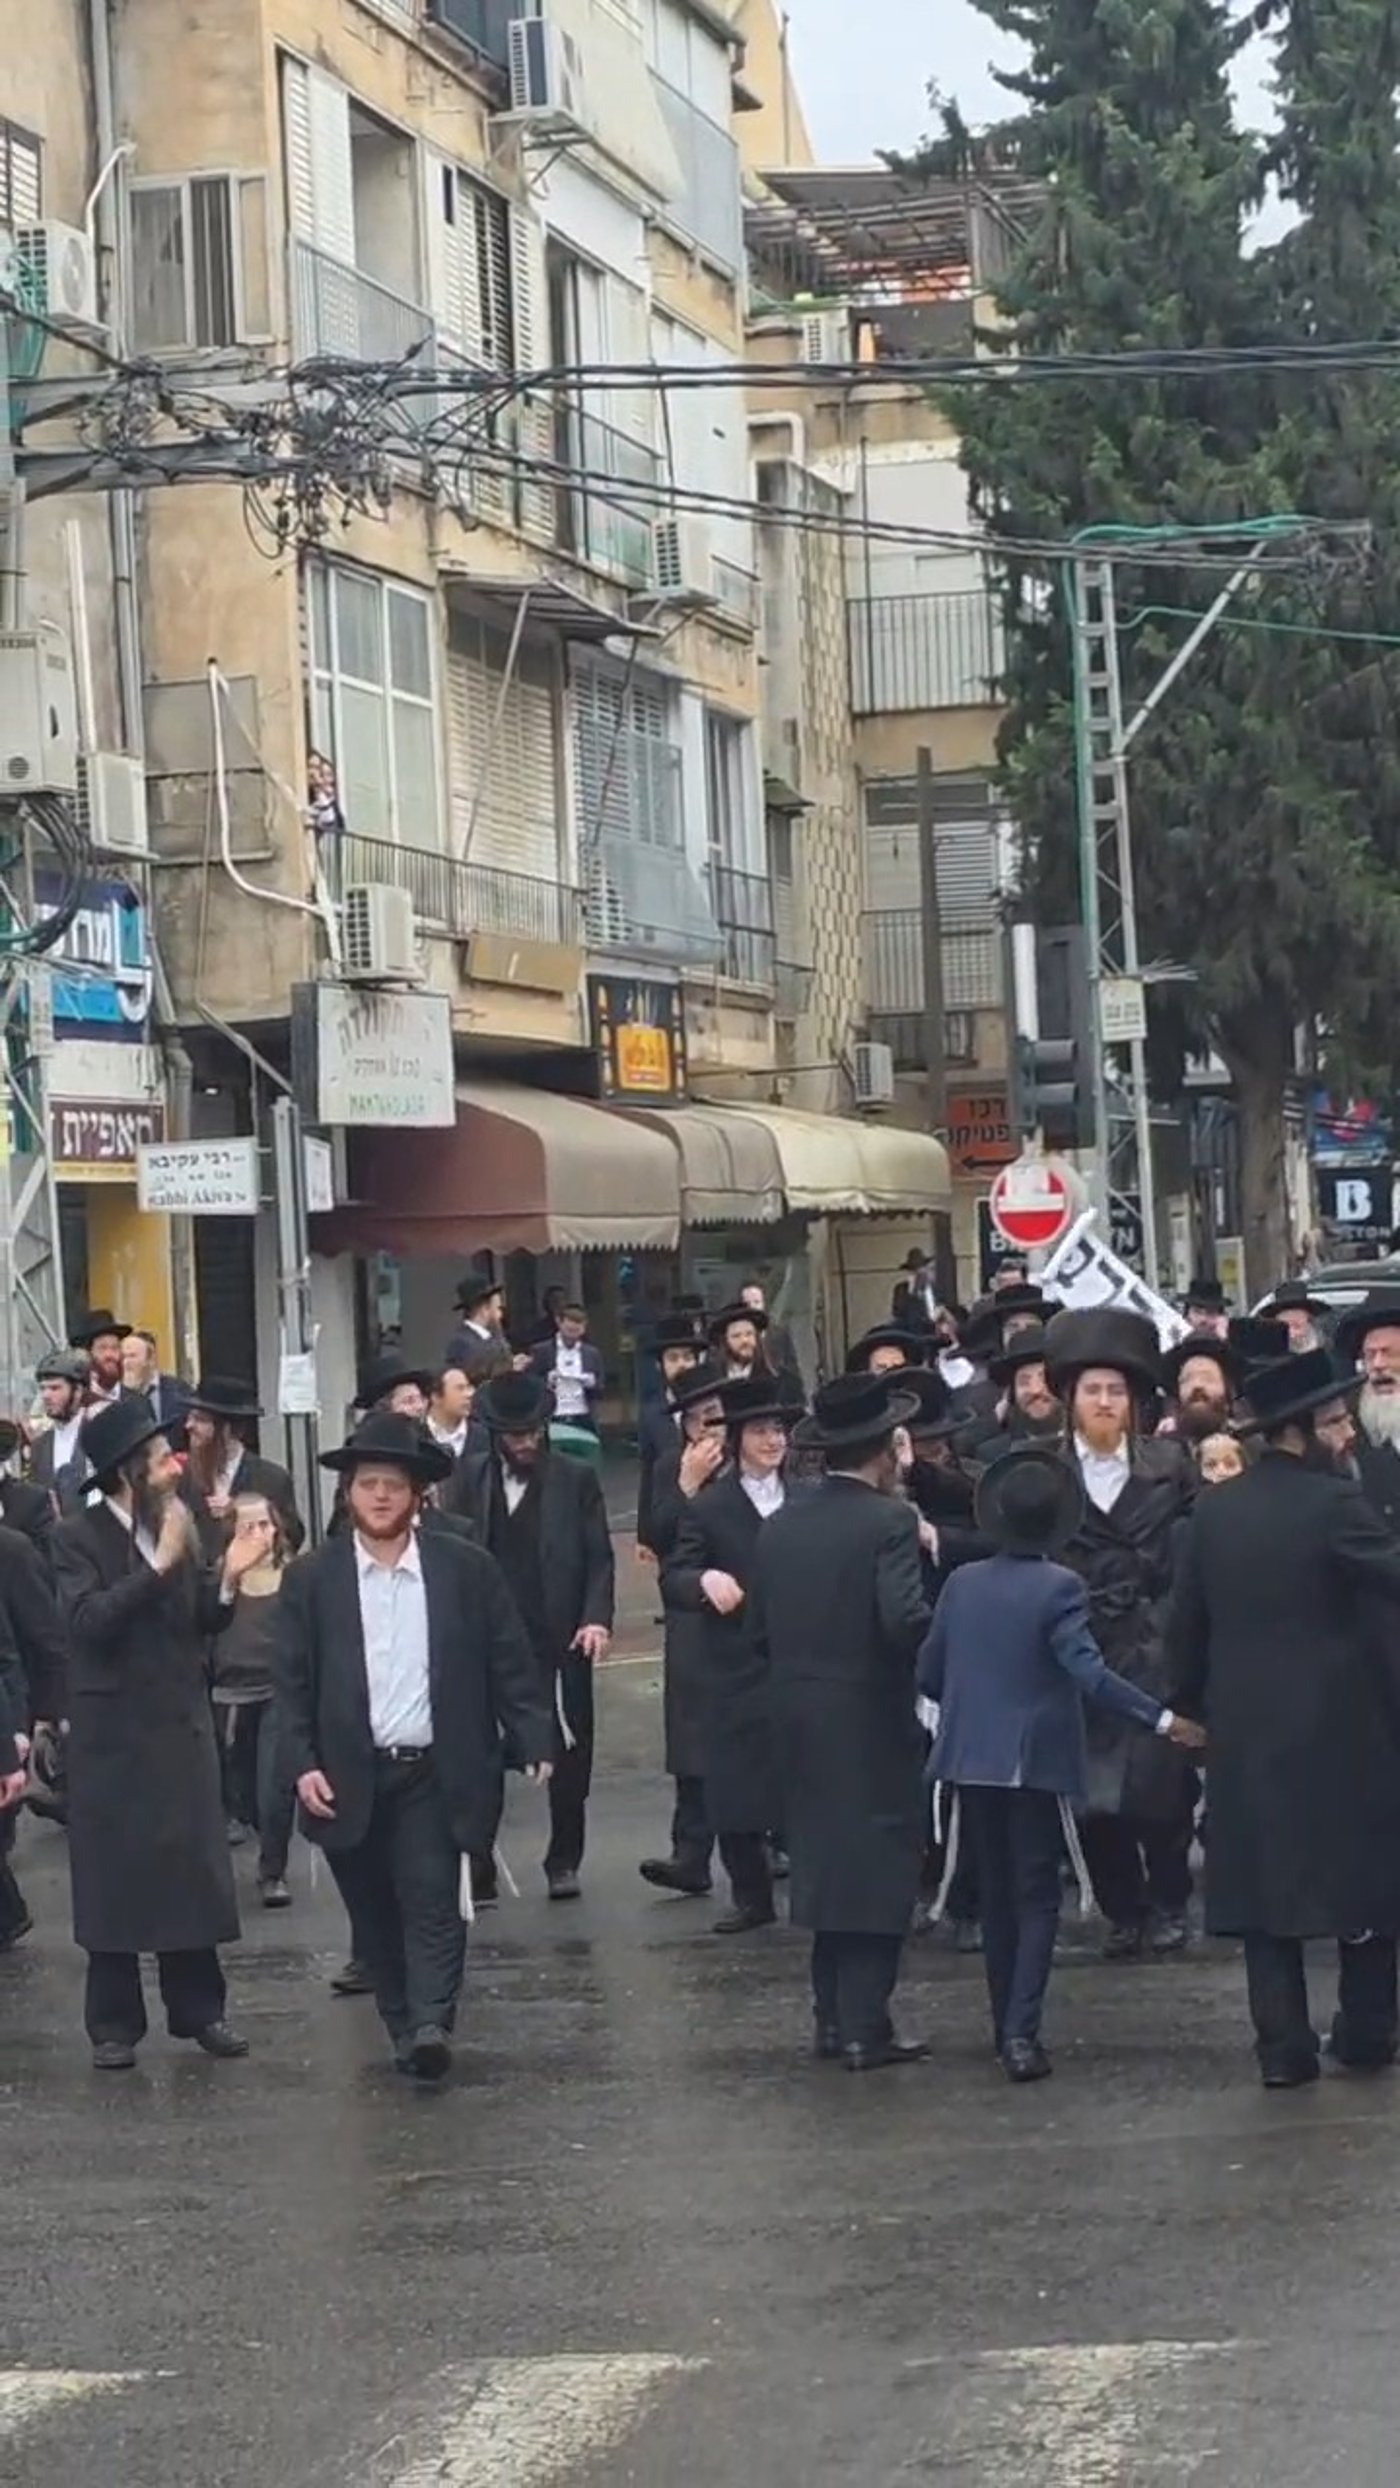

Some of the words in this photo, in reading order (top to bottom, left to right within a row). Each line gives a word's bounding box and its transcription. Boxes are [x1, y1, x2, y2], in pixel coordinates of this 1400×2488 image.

[148, 1154, 200, 1169] עקיבא
[203, 1151, 231, 1165] רבי
[190, 1187, 232, 1204] Akiva
[1336, 1179, 1372, 1221] B
